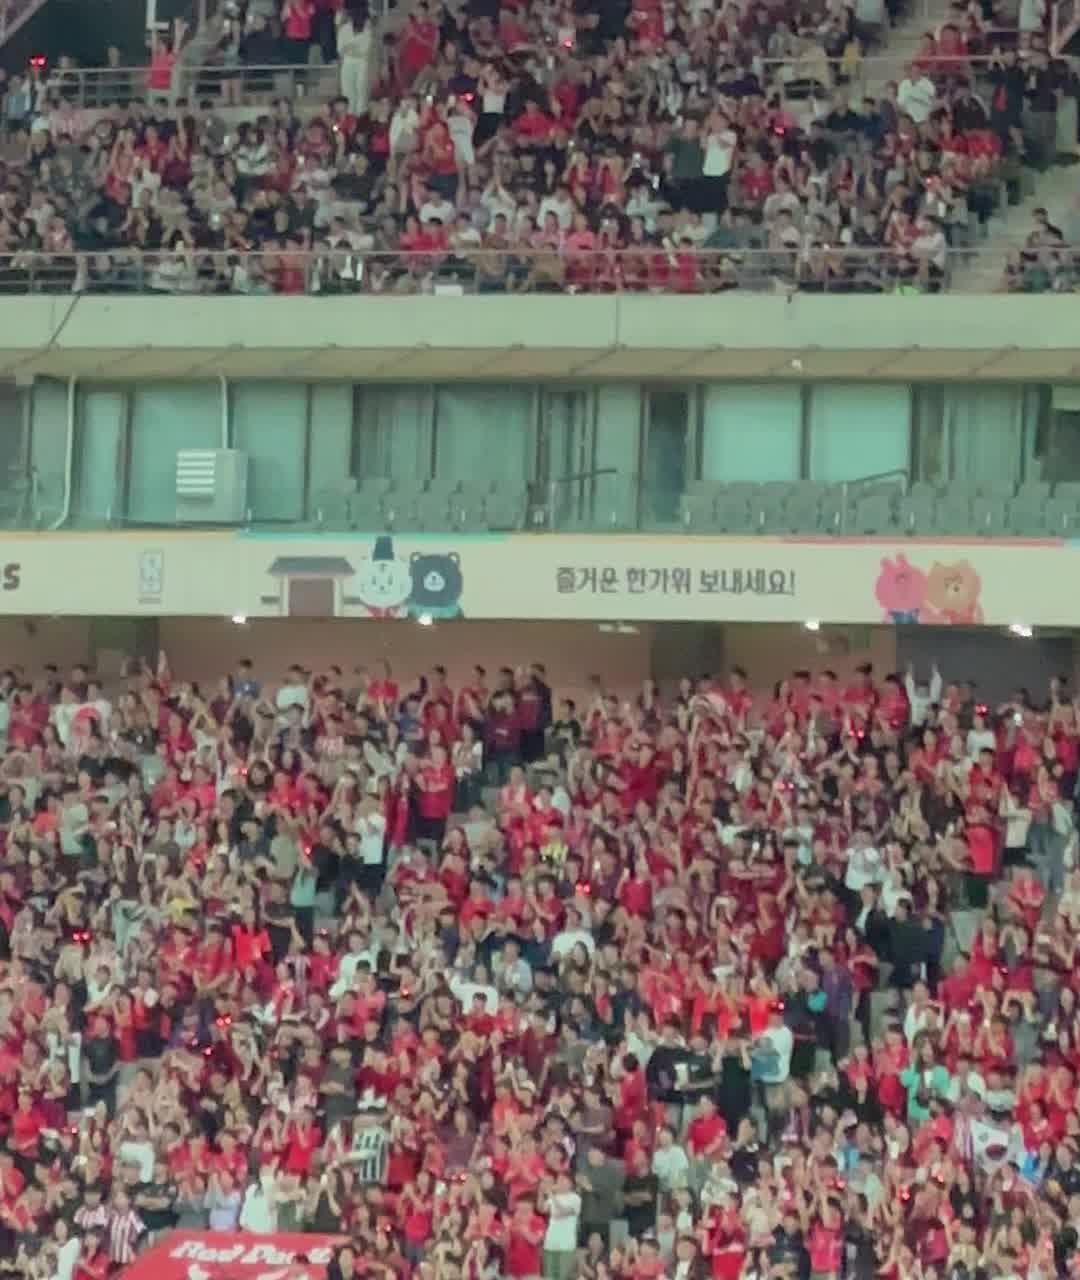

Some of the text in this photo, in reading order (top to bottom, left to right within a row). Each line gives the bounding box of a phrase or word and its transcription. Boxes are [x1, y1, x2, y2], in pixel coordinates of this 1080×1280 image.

[556, 566, 796, 597] 즐거운 한가위 보내세요!
